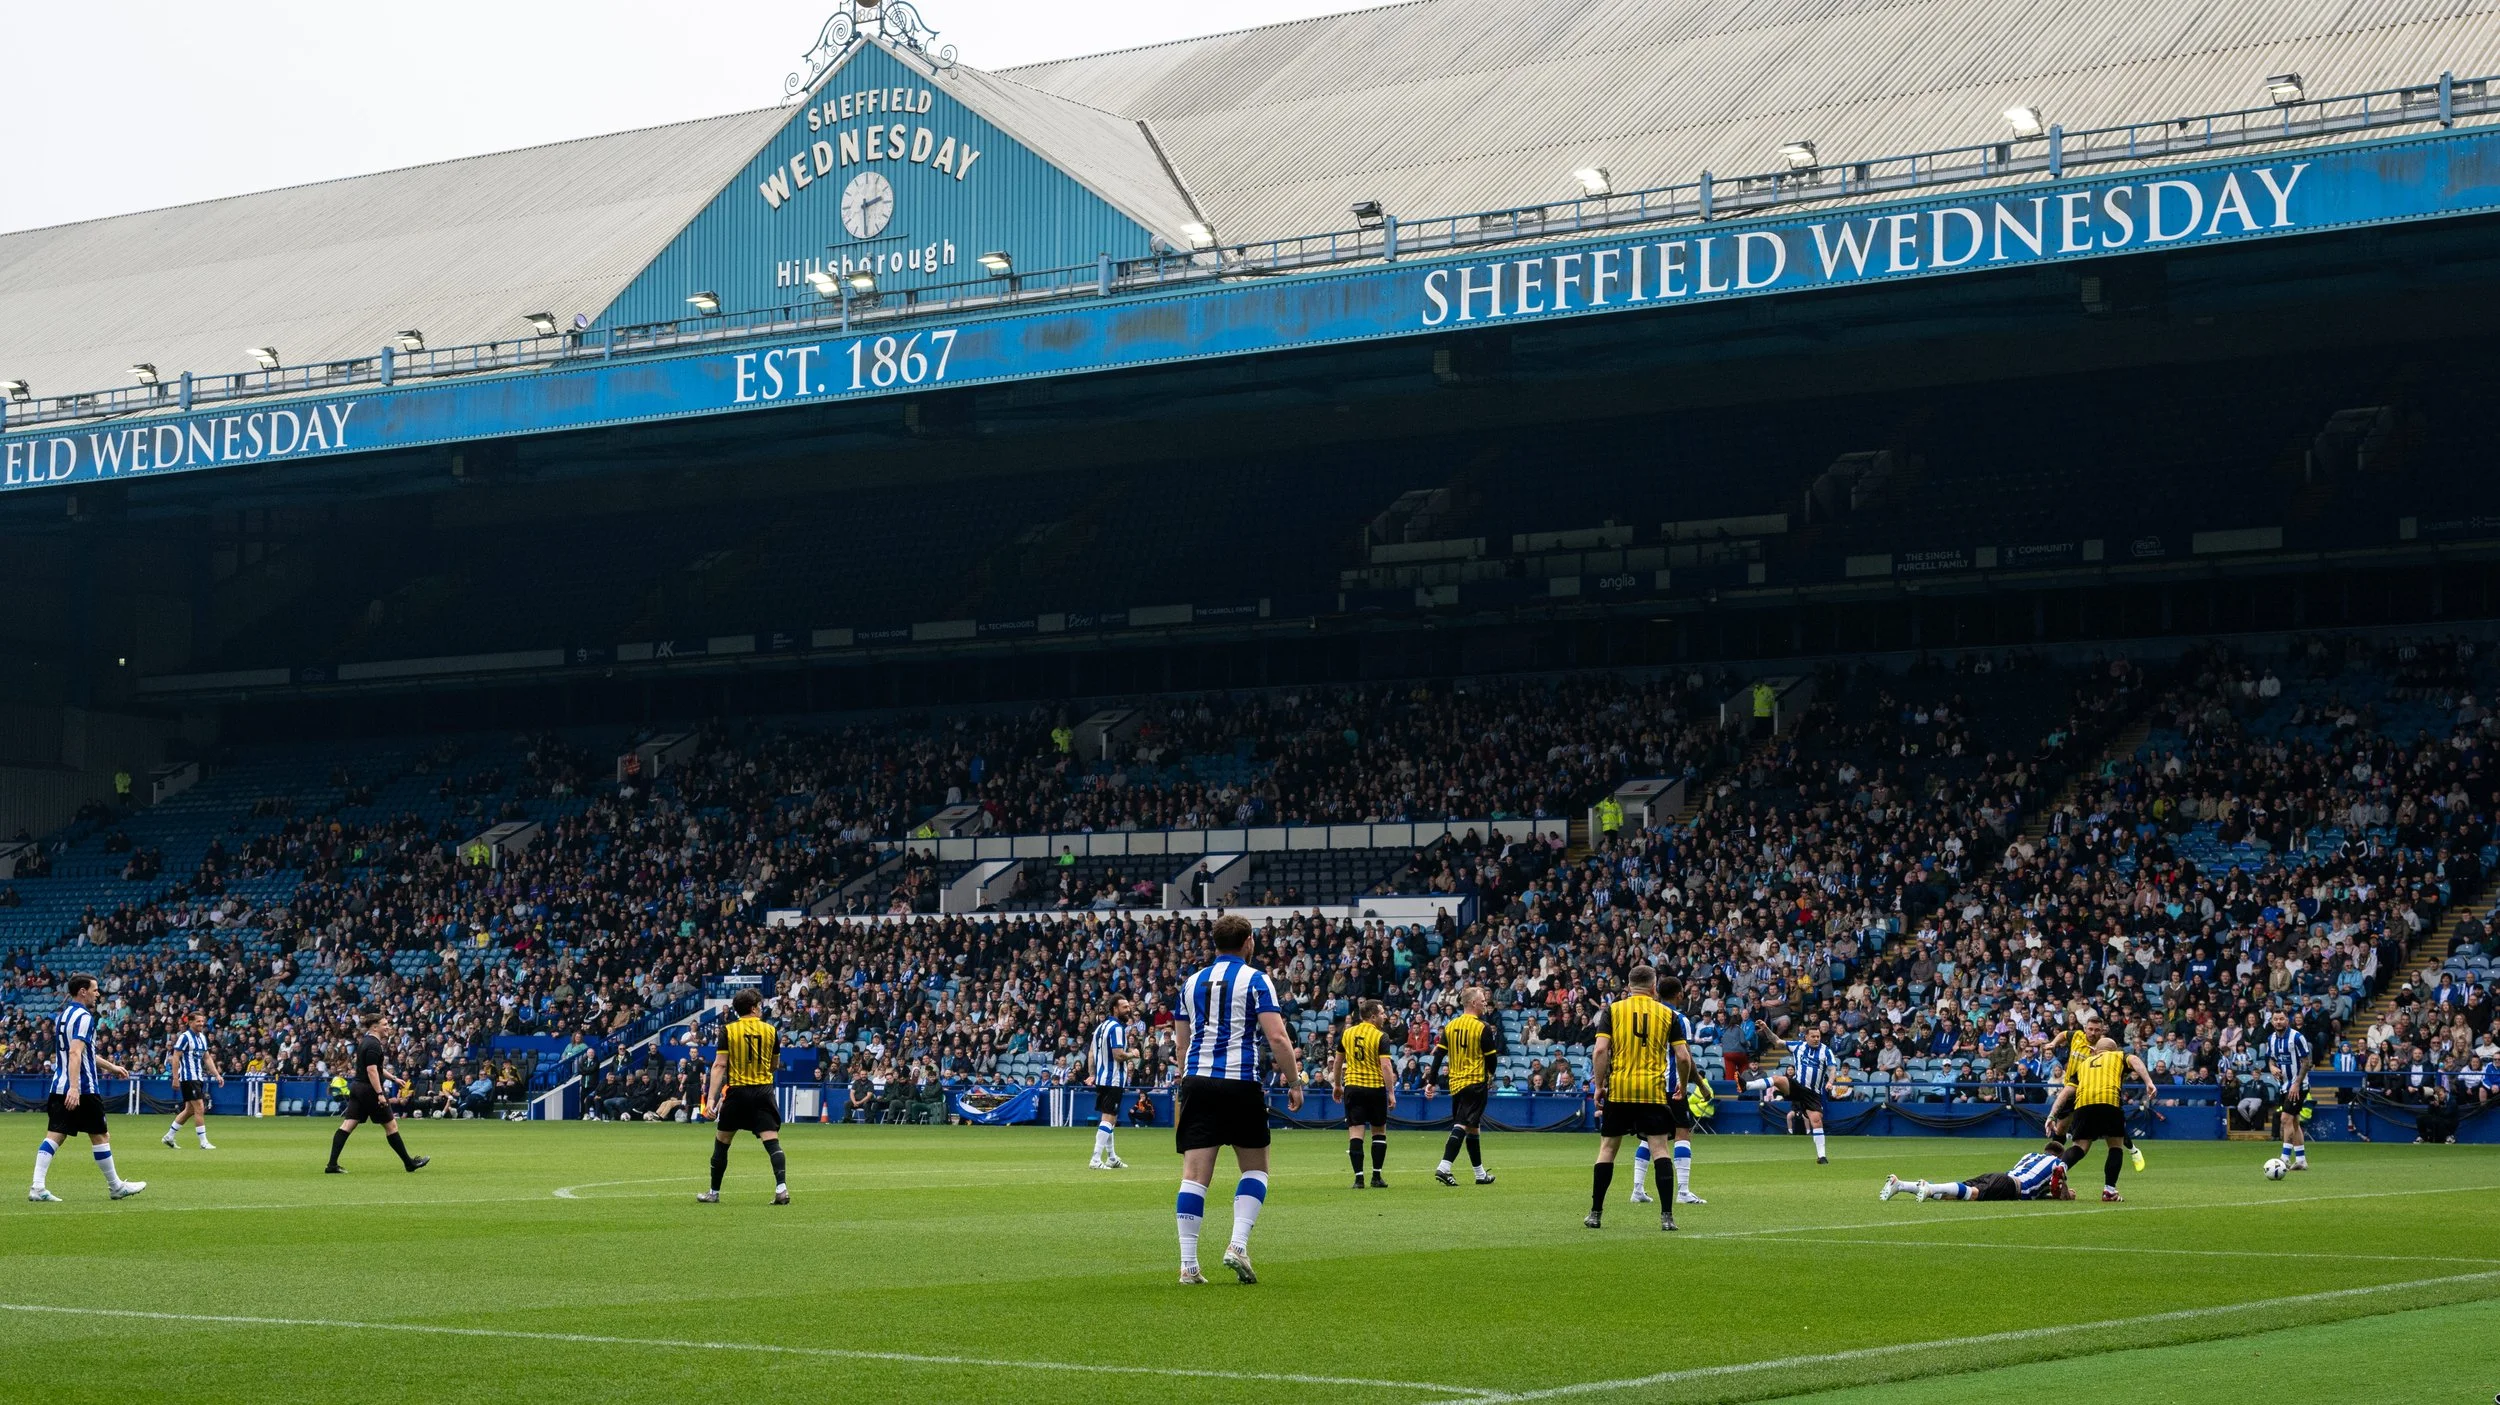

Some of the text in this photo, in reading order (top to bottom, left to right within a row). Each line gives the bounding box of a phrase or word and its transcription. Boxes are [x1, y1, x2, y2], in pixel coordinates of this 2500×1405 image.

[807, 87, 933, 132] SHEFFIELD
[759, 123, 981, 210] WEDNESDAY
[777, 238, 956, 288] Hillsborough
[1422, 163, 2310, 327] SHEFFIELD WEDNESDAY
[733, 329, 958, 403] EST. 1867
[4, 402, 357, 486] ELD WEDNESDAY
[1897, 559, 1969, 573] PURCELL FAMILY
[1905, 553, 1923, 562] THE
[1924, 551, 1954, 561] SINGH
[2018, 543, 2075, 555] COMMUNITY
[1599, 573, 1636, 591] anglia
[1200, 980, 1228, 1026] 11
[1354, 1036, 1365, 1061] 5
[1632, 1011, 1648, 1047] 4
